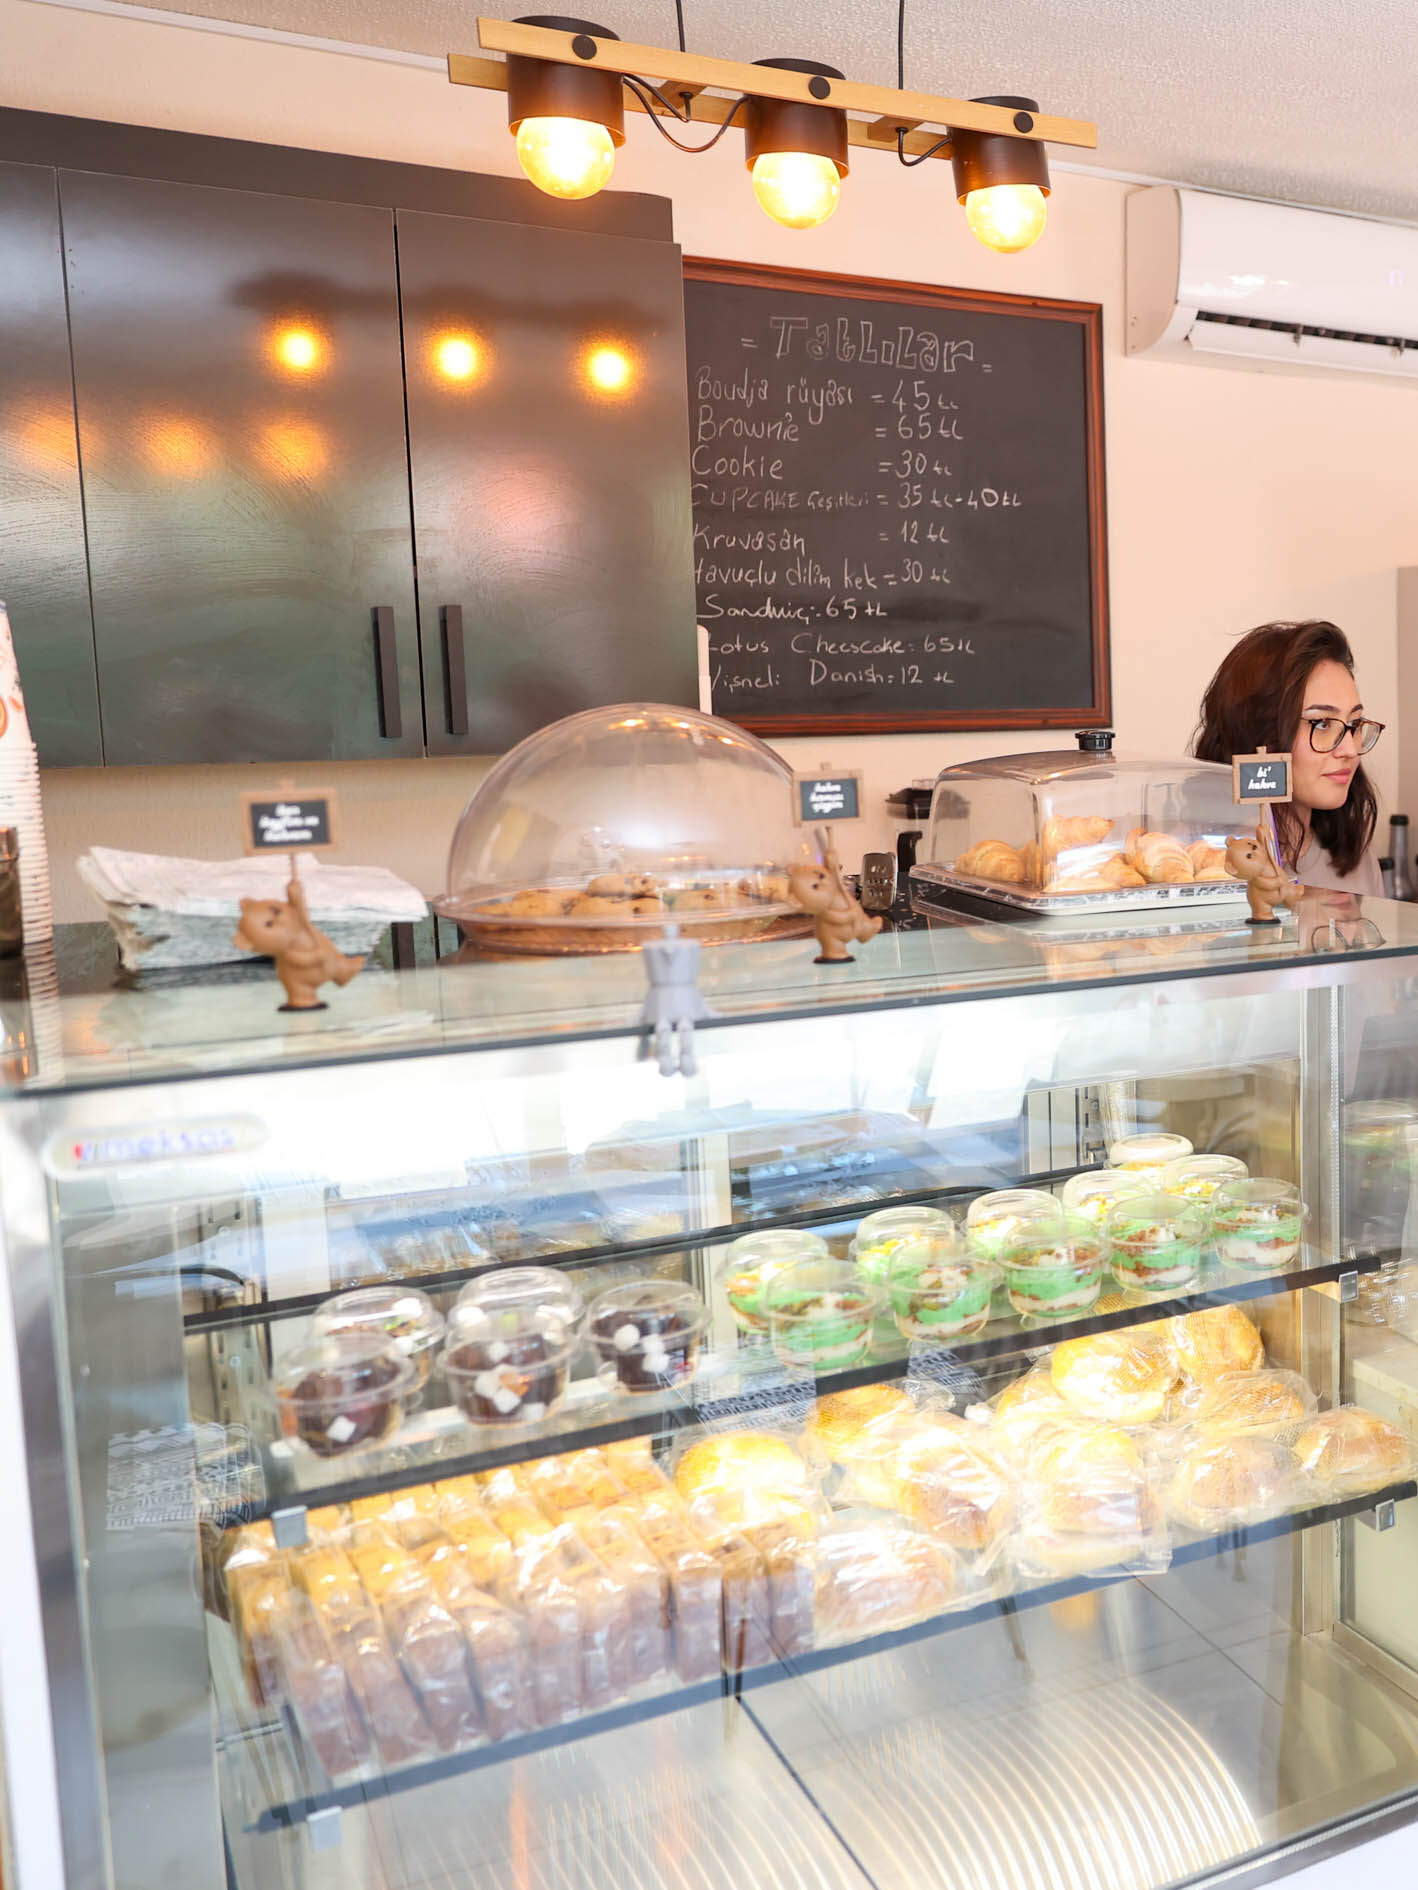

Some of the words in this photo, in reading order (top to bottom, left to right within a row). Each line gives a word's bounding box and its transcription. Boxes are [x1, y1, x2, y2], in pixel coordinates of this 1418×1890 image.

[698, 404, 800, 442] Brownie
[691, 445, 784, 480] Cookie
[692, 522, 805, 557] Kruvasan
[786, 556, 831, 589] dilim
